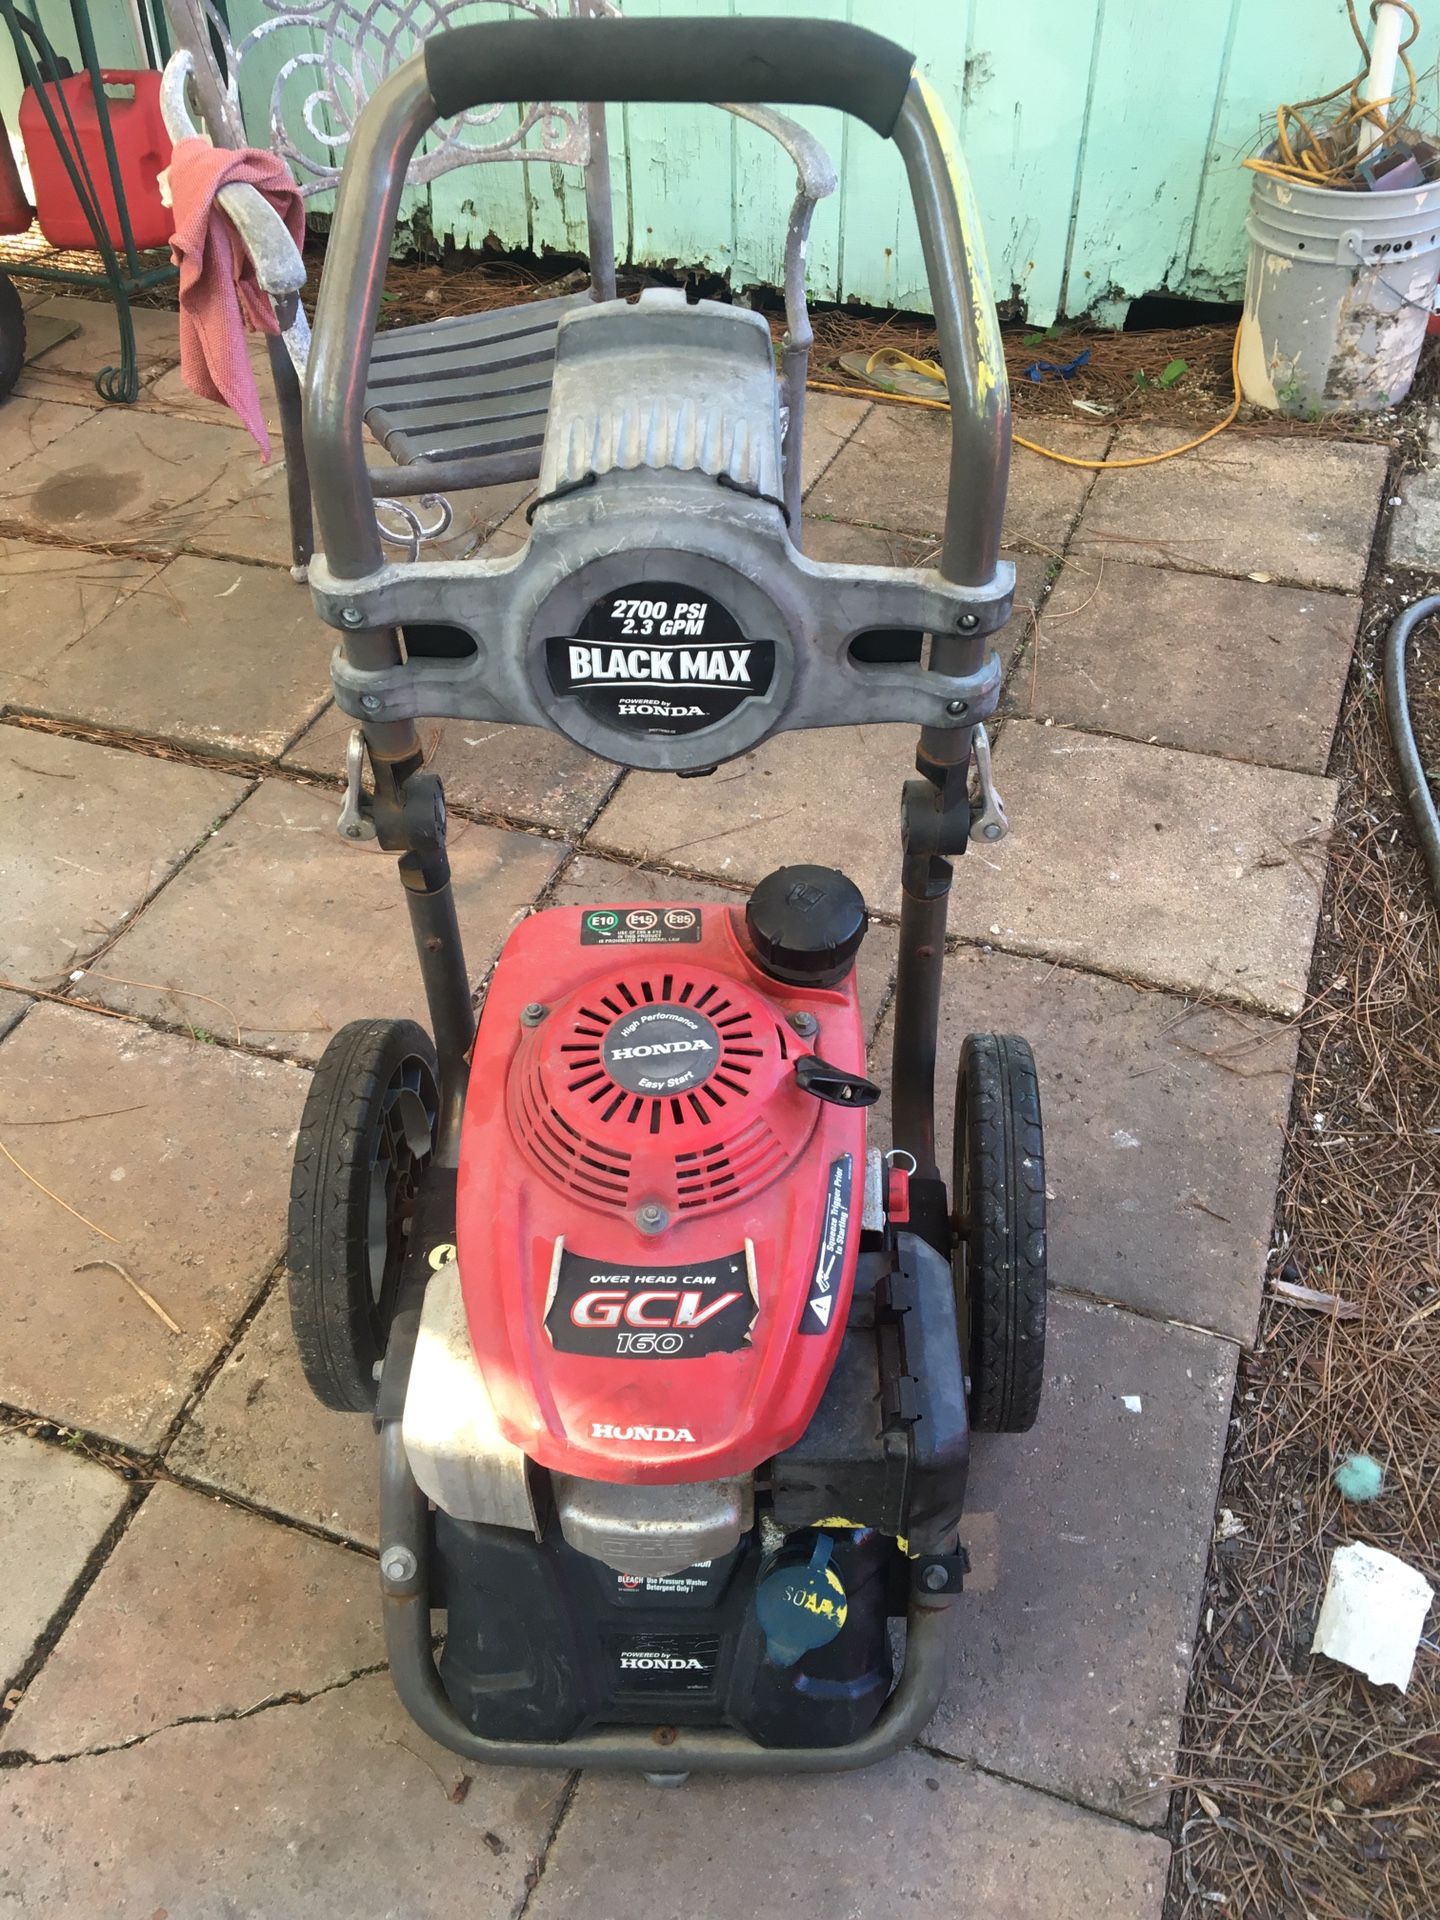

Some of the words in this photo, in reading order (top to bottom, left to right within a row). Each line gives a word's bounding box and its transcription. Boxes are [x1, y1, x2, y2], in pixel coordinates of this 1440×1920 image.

[611, 600, 668, 620] 2700
[674, 603, 708, 619] PSI
[621, 619, 654, 635] 2.3
[659, 619, 705, 636] GPM
[568, 646, 674, 680] BLACK
[680, 649, 752, 682] MAX
[618, 705, 706, 717] HONDA
[591, 916, 615, 926] E10
[669, 914, 691, 924] E85
[621, 1020, 640, 1037] High
[641, 1012, 699, 1030] Performance
[611, 1039, 713, 1061] HONDA
[638, 1077, 665, 1090] Easy
[667, 1070, 695, 1088] Start
[834, 1167, 844, 1188] Prior
[831, 1187, 842, 1216] Trigger
[826, 1217, 838, 1252] Squeeze
[836, 1211, 849, 1245] Starting
[835, 1245, 843, 1256] to
[589, 1275, 631, 1284] OVER
[634, 1275, 678, 1284] HEAD
[682, 1275, 717, 1285] CAM
[570, 1290, 744, 1328] GCV
[616, 1333, 684, 1354] 160
[591, 1423, 697, 1443] HONDA
[617, 1575, 643, 1583] BLEACH
[646, 1584, 675, 1592] Detergent
[676, 1585, 689, 1594] Only
[782, 1585, 834, 1620] SOAP
[620, 1658, 704, 1669] HONDA
